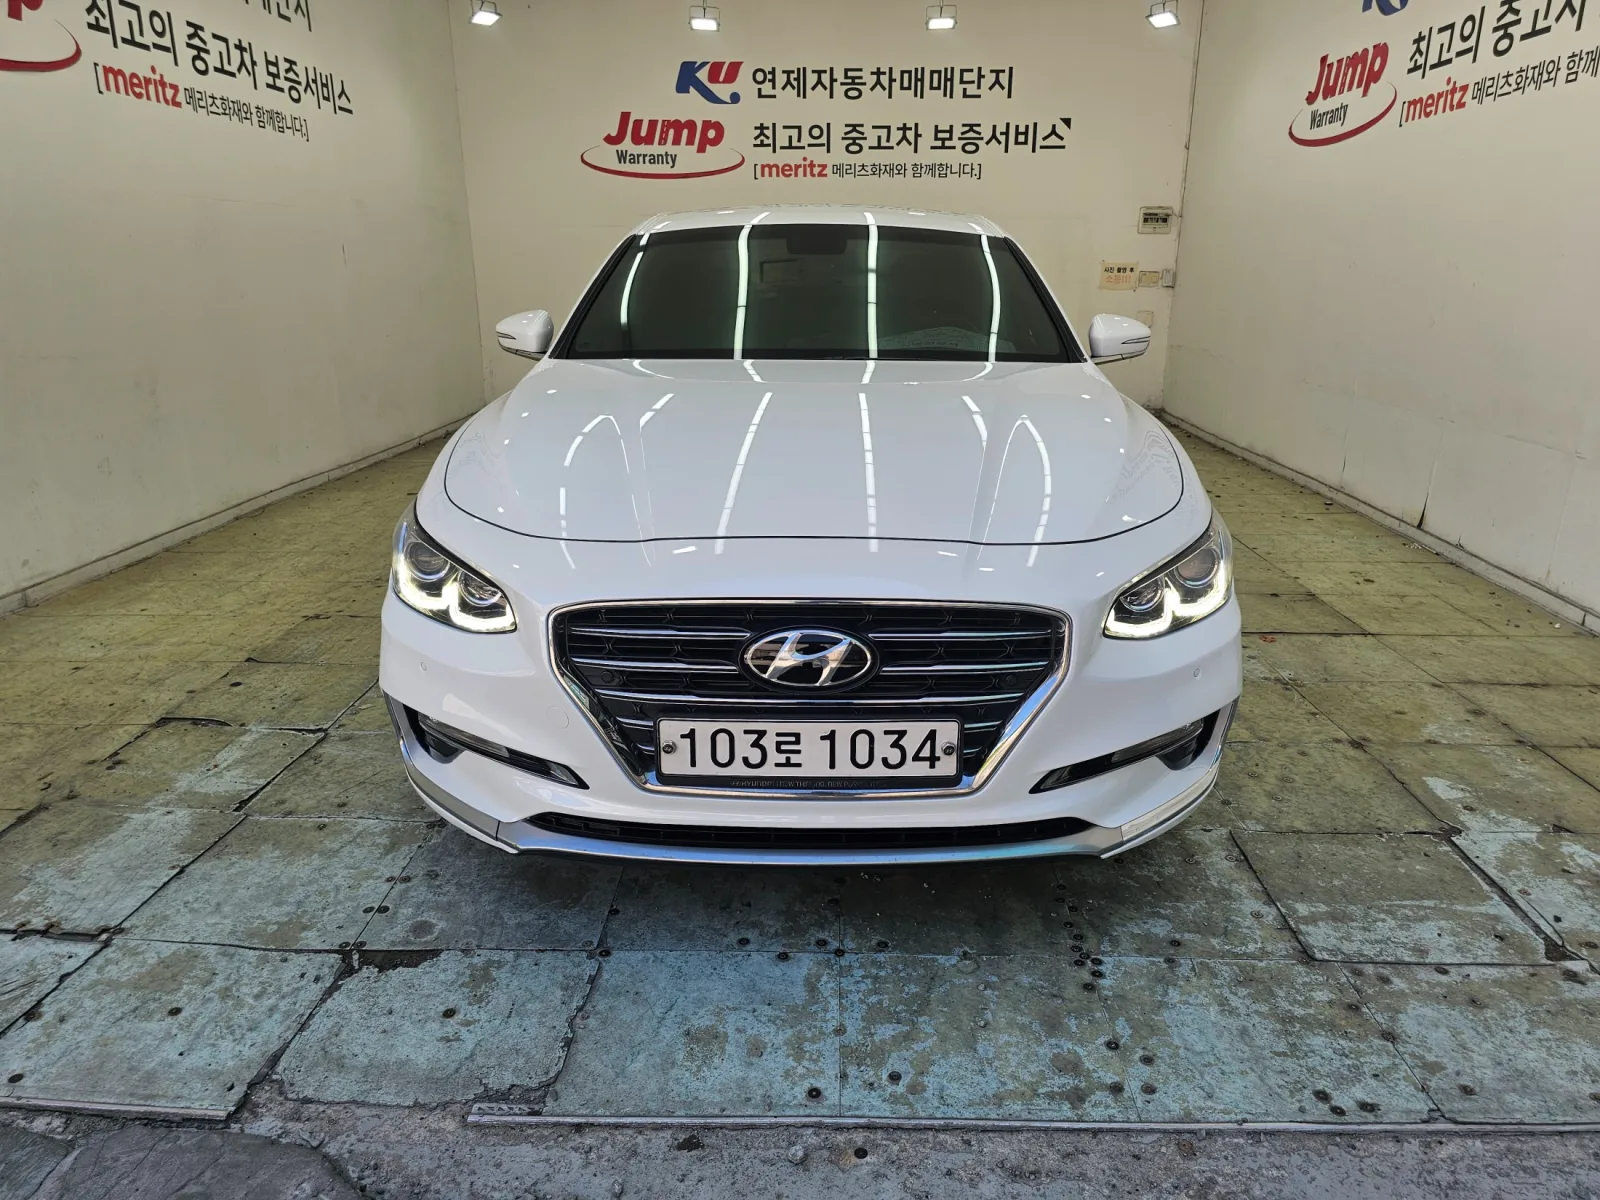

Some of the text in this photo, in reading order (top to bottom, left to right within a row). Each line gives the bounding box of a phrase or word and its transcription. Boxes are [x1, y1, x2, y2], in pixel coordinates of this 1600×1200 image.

[85, 0, 180, 66] 최고의
[185, 20, 259, 91] 중고차
[264, 51, 354, 115] 보증서비스
[1407, 5, 1486, 79] 최고의
[675, 61, 744, 104] KU
[752, 66, 1014, 100] 연제자동차매매단지
[1305, 42, 1390, 105] Jump
[1471, 55, 1561, 105] 메리츠화재와
[183, 87, 253, 126] 메리츠화재와
[1309, 102, 1349, 131] Warranty
[603, 111, 725, 153] Jump
[753, 121, 1066, 155] 최고의 중고차 보증서비스
[616, 149, 677, 168] Warranty
[832, 162, 908, 179] 메리츠화재와
[679, 727, 941, 770] 103로 1034
